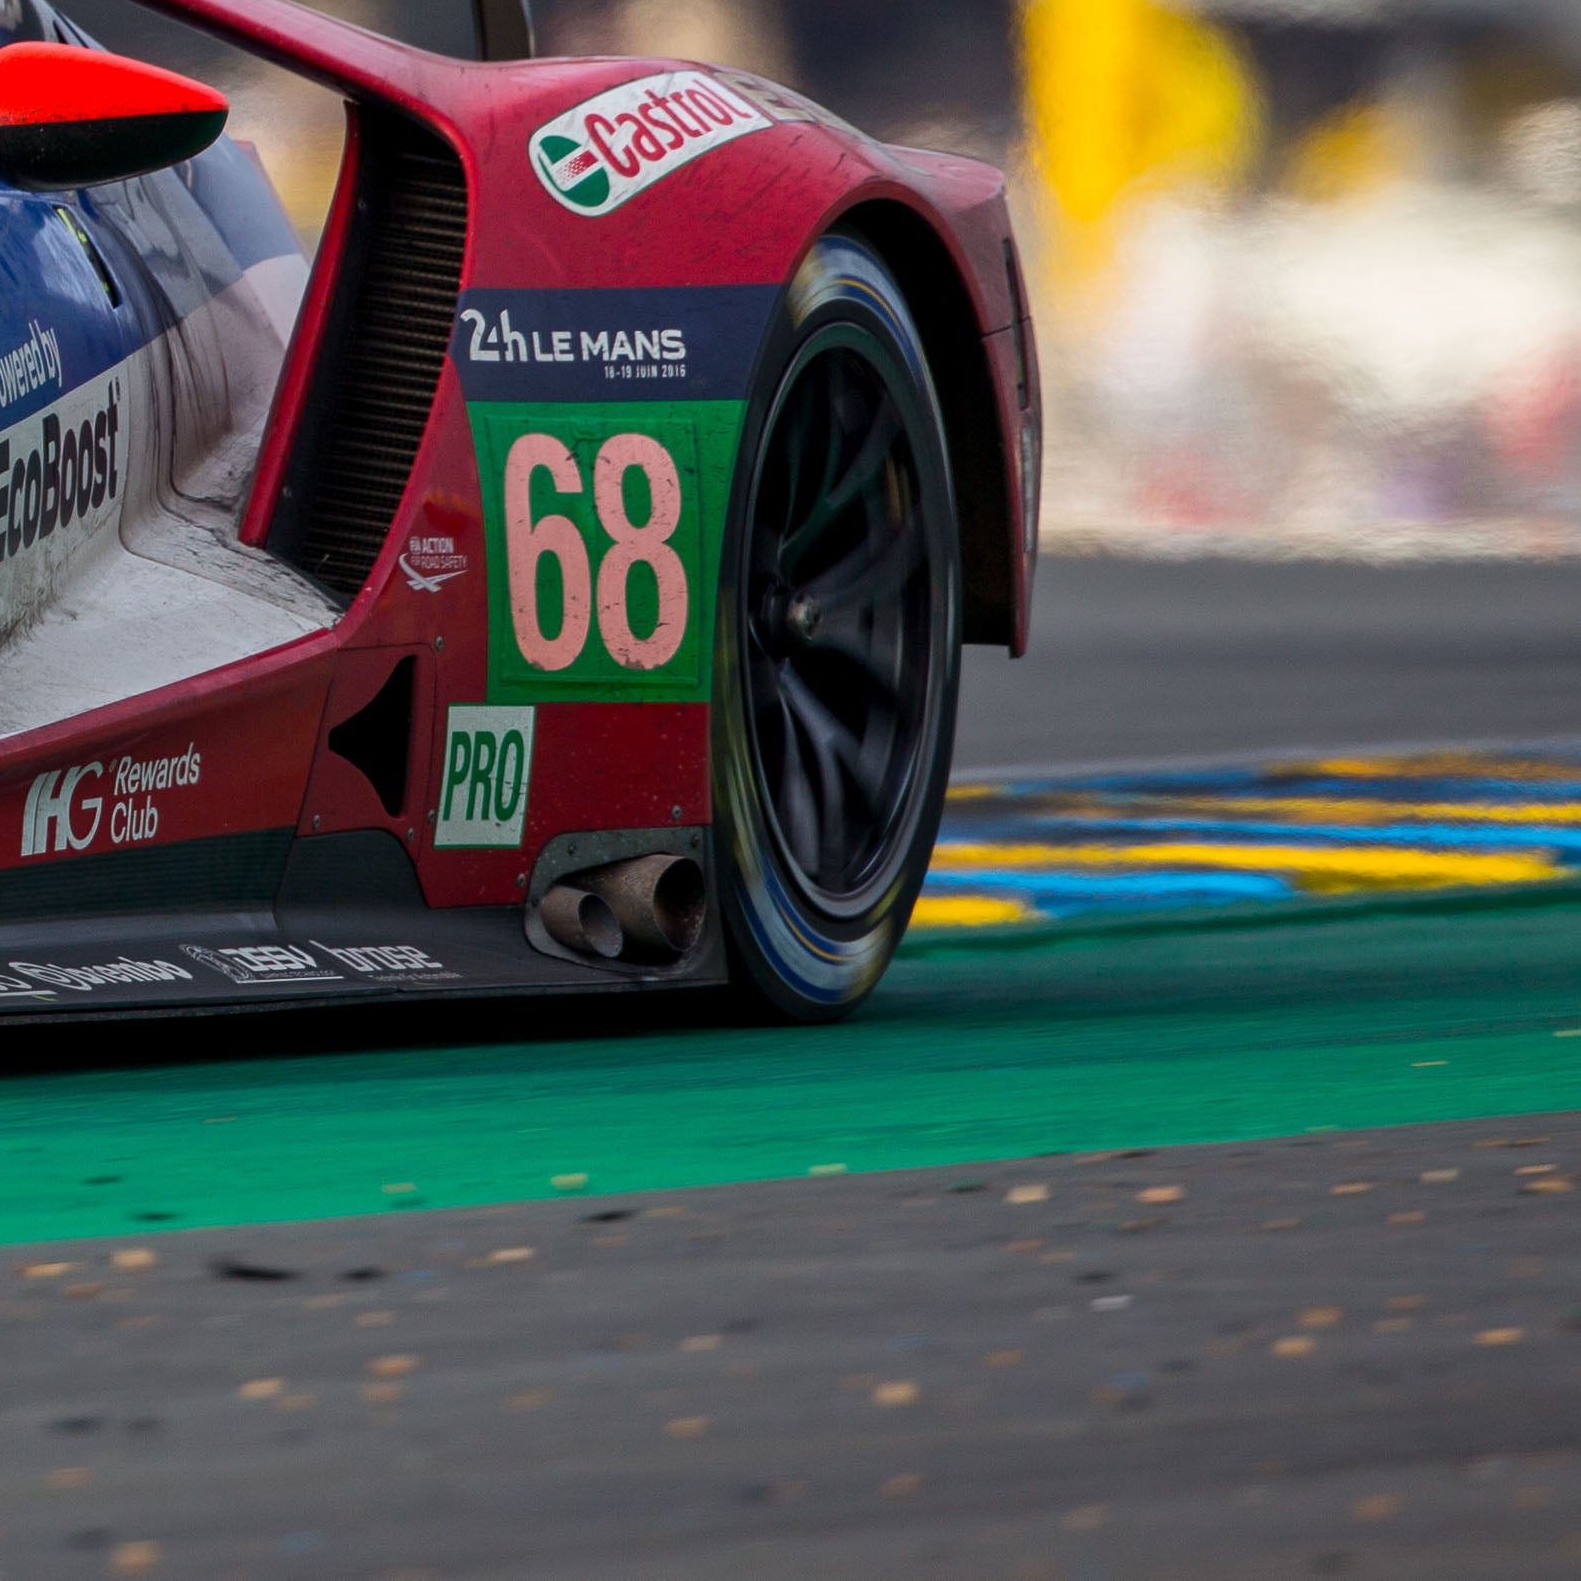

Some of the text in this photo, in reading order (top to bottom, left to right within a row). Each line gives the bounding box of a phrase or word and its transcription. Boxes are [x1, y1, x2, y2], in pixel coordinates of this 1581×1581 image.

[584, 79, 752, 178] Castrol
[34, 319, 62, 388] by
[532, 331, 575, 362] LE
[580, 329, 686, 362] MANS
[662, 364, 686, 378] 2016
[504, 431, 690, 672] 68
[113, 741, 201, 796] Rewards
[442, 728, 525, 822] PRO
[21, 761, 103, 857] IHG
[110, 795, 159, 845] Club
[308, 939, 443, 973] brose
